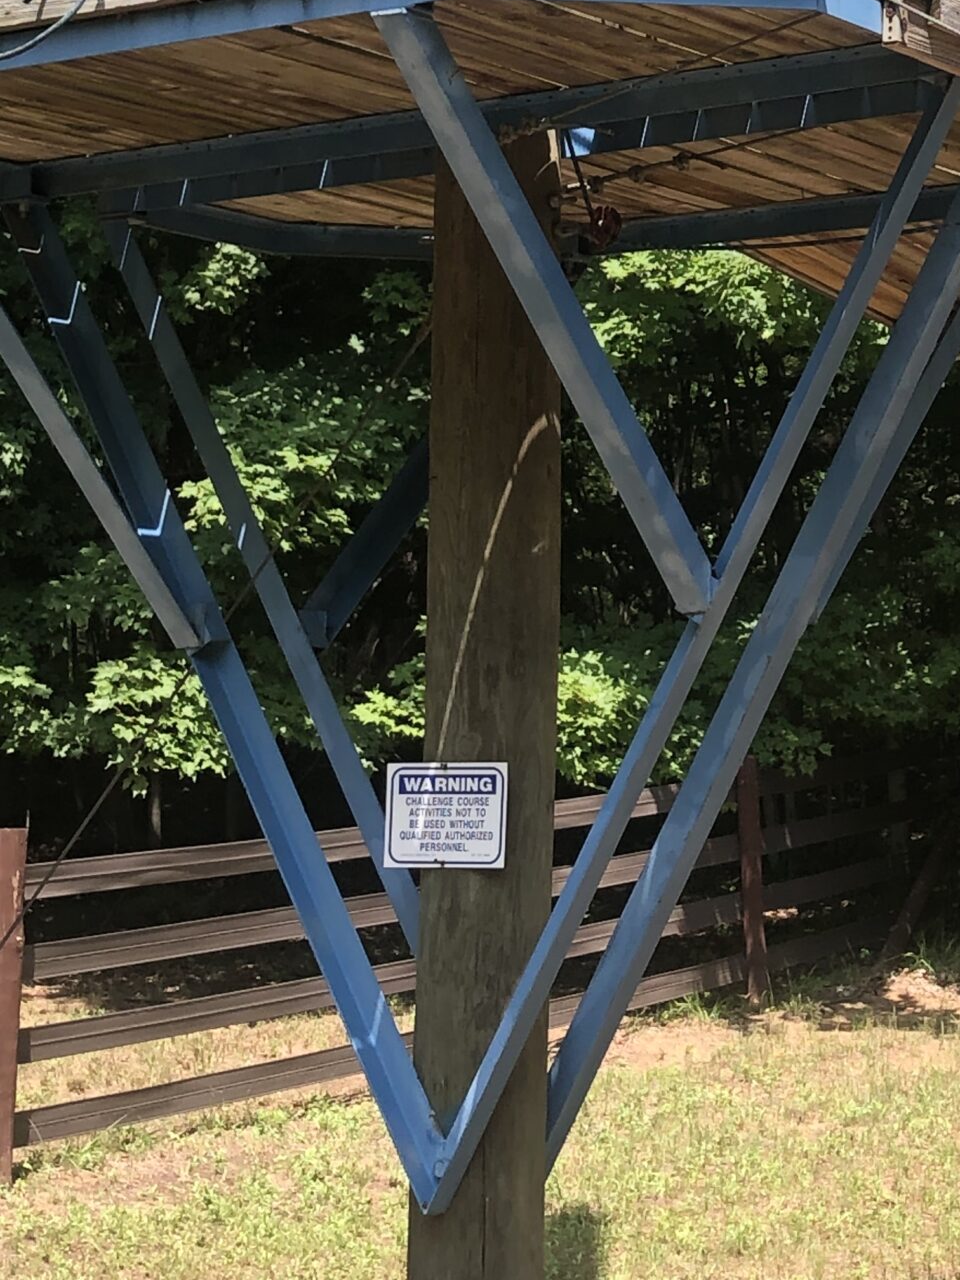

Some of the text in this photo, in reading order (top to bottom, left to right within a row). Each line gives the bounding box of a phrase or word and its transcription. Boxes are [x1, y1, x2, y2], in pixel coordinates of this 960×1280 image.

[403, 777, 493, 792] WARNING
[405, 797, 490, 806] CHALLENGE COURSE
[409, 808, 487, 817] ACTIVITIES NOT TO
[409, 820, 485, 829] BE USED WITHOUT
[399, 831, 493, 840] QUALIFIED AUTHORIZED
